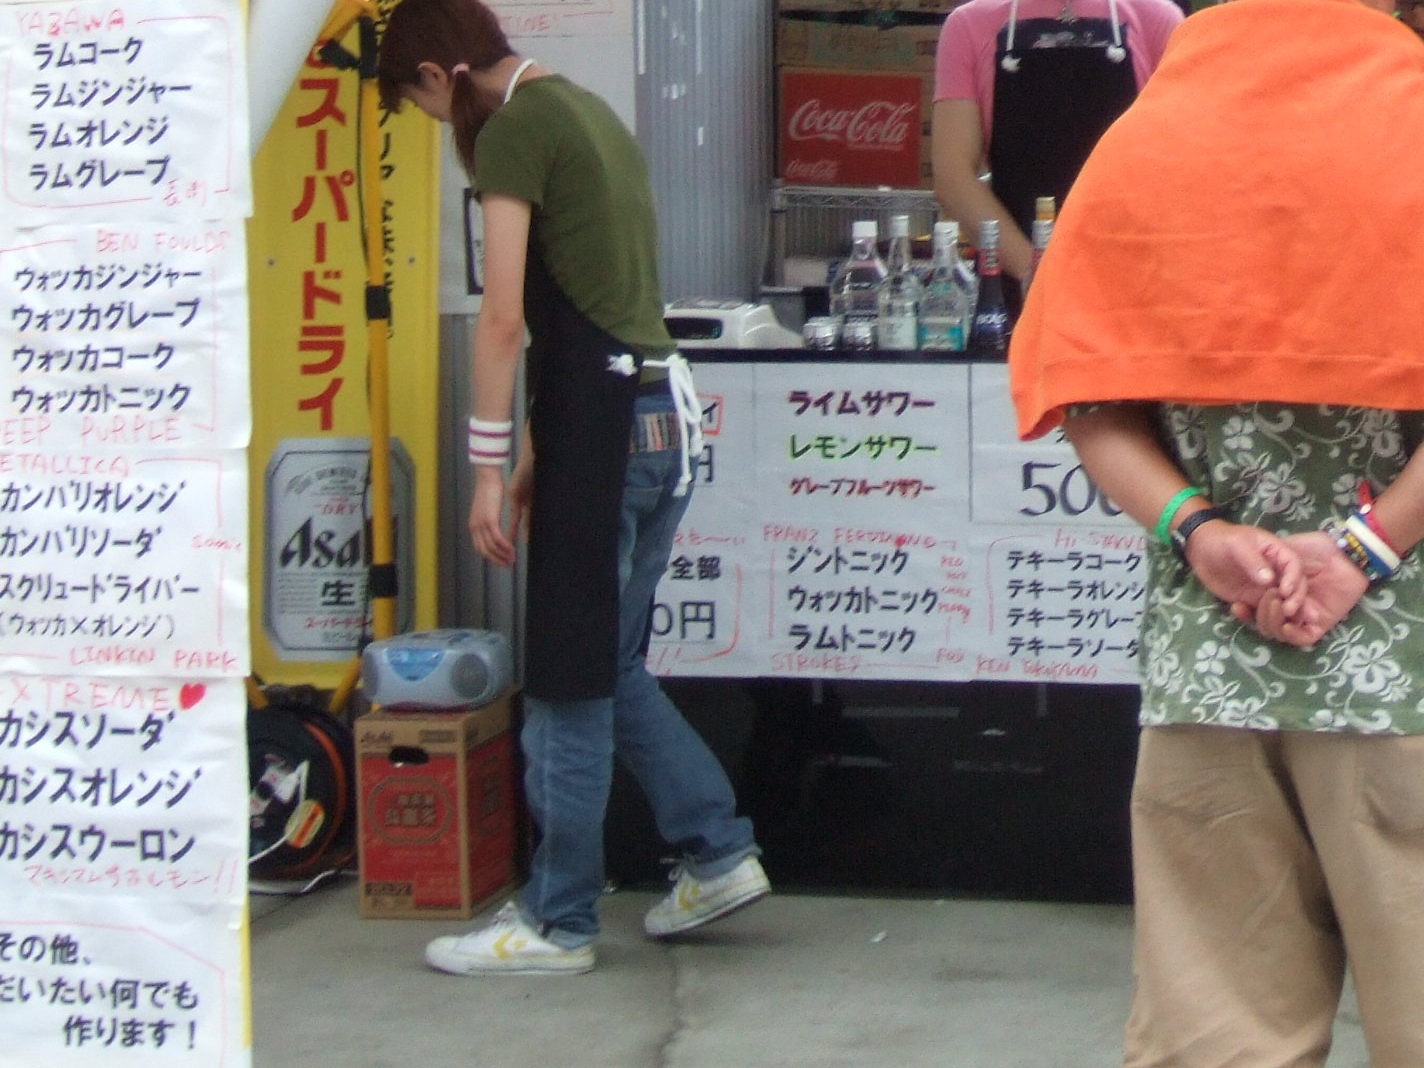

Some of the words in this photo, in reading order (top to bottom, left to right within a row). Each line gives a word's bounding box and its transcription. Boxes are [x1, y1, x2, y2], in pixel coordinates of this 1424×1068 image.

[32, 36, 144, 70] ラムコーク
[30, 76, 193, 110] ラムジンジャー
[28, 114, 172, 151] ラムオレンジ
[29, 155, 173, 191] ラムグレープ
[290, 77, 356, 432] スーパードライ
[13, 262, 202, 292] ウォッカジンジャー
[11, 296, 201, 332] ウォッカグレープ
[11, 342, 176, 373] ウォッカコーク
[11, 383, 191, 415] ウォッカトニック
[788, 389, 936, 418] ライムサワー
[789, 433, 938, 462] レモンサワー
[787, 546, 910, 575] ジントニック
[1007, 550, 1142, 573] テキーラコーク
[320, 579, 356, 607] 生
[787, 584, 939, 616] ウォッカトニック
[1007, 607, 1143, 629] テキーラグレー
[788, 624, 917, 653] ラムトニック
[0, 709, 177, 753] カシスソーダ
[0, 765, 203, 810] カシスオレンジ
[0, 824, 197, 864] カシスウーロン
